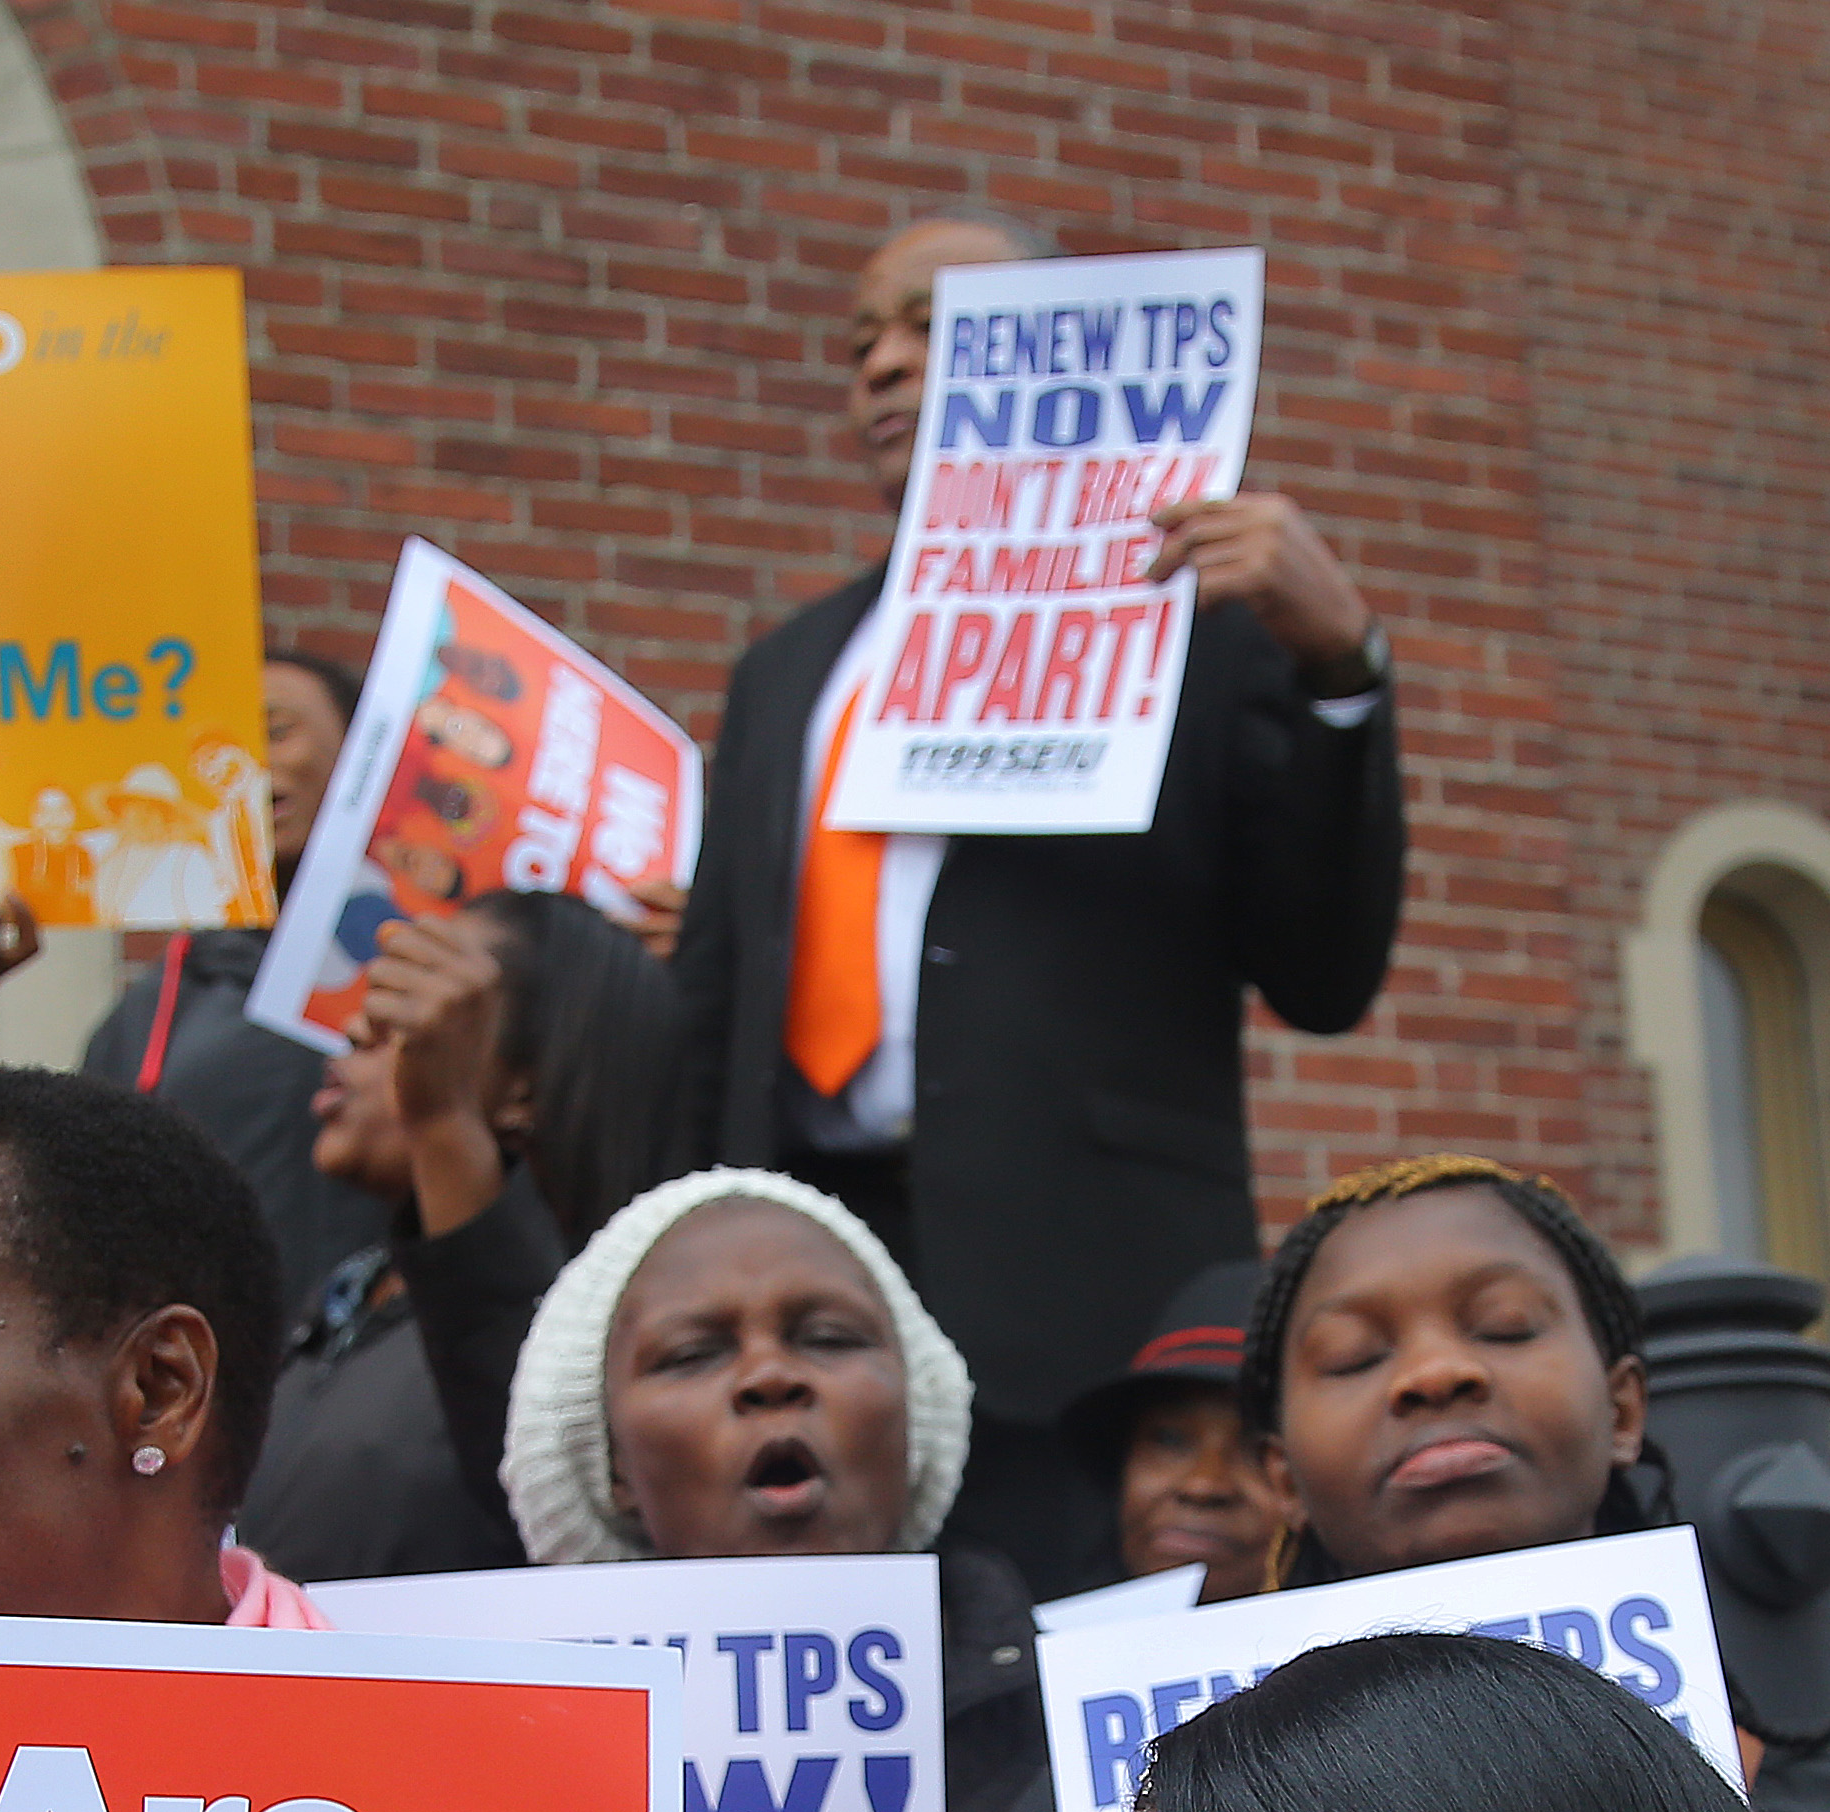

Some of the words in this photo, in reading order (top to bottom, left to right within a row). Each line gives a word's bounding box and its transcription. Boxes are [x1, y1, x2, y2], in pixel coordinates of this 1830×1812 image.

[950, 303, 1122, 378] RENEW
[1142, 298, 1235, 369] TPS
[940, 381, 1227, 447] NOW
[908, 533, 1163, 594] FAMILIE
[876, 600, 1175, 725] APART!
[717, 1630, 905, 1733] TPS
